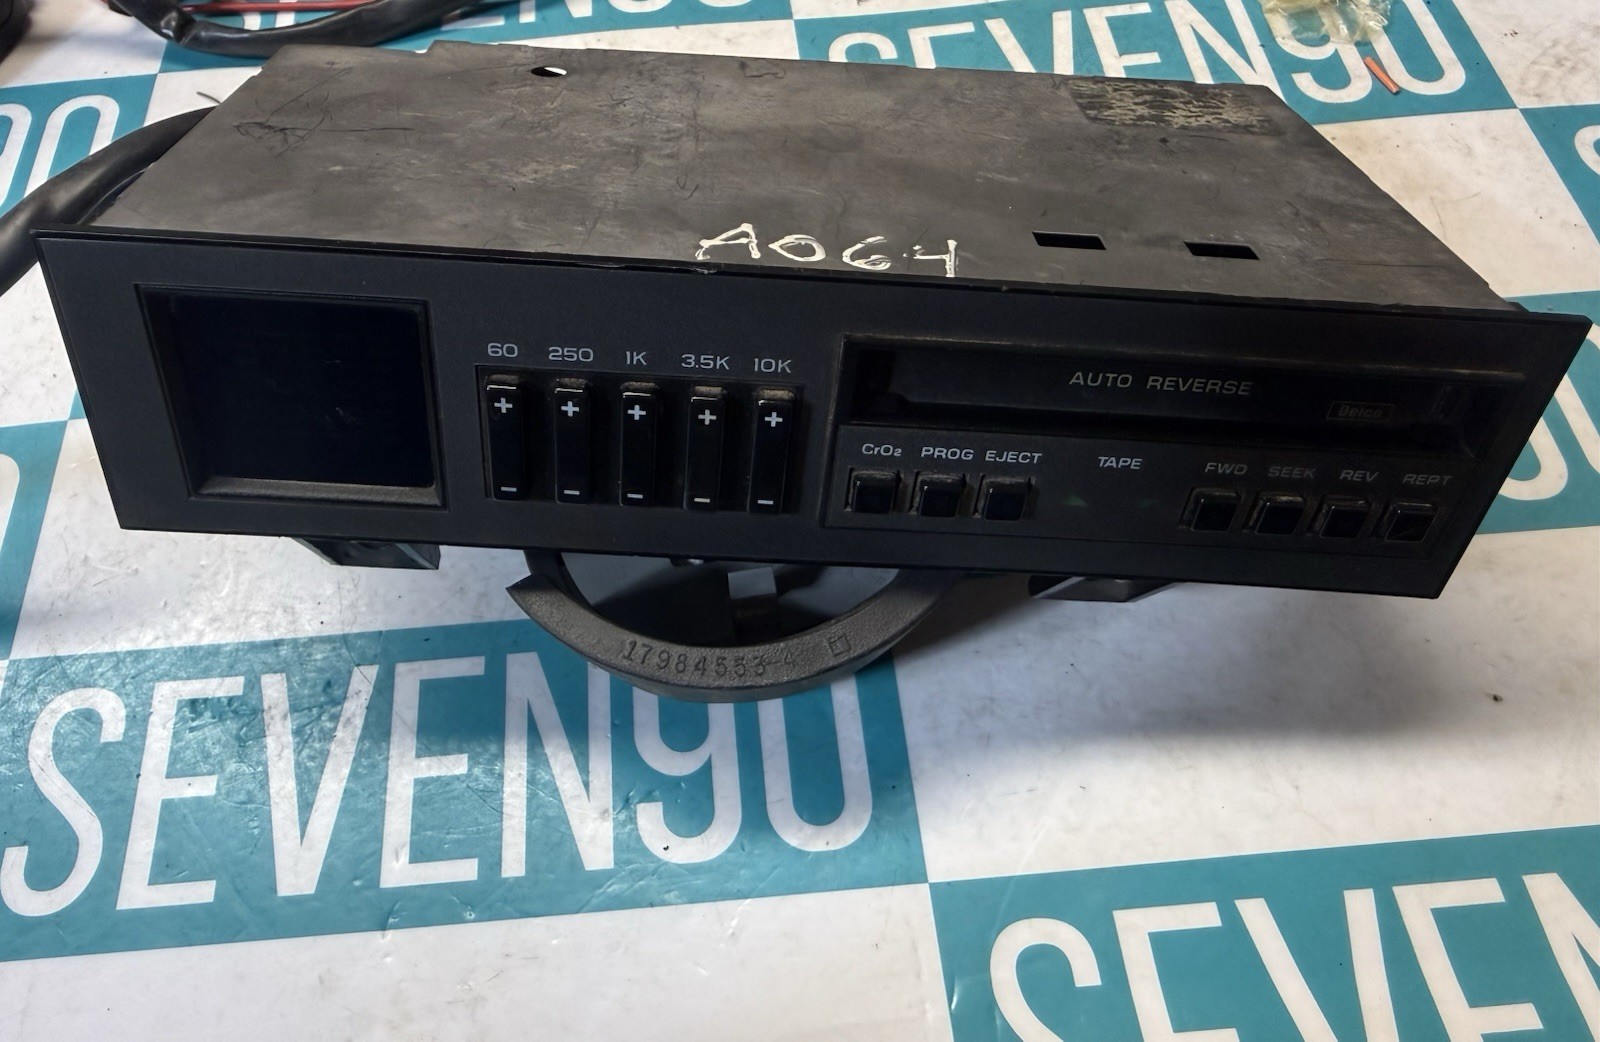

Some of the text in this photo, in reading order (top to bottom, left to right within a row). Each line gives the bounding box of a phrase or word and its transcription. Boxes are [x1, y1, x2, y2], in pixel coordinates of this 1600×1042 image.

[487, 342, 519, 358] 60
[548, 346, 594, 362] 250
[625, 350, 648, 366] 1K
[681, 353, 730, 371] 3.5K
[753, 357, 792, 374] 10K
[1068, 371, 1253, 395] AUTO REVERSE
[920, 445, 975, 461] PROG
[984, 449, 1043, 464] EJECT
[1097, 456, 1143, 470] TAPE
[1204, 462, 1248, 476] FWD
[1267, 465, 1316, 479] SEEK
[1339, 468, 1379, 483] REV
[1402, 472, 1453, 487] REPT
[3, 651, 874, 917] SEVEN90
